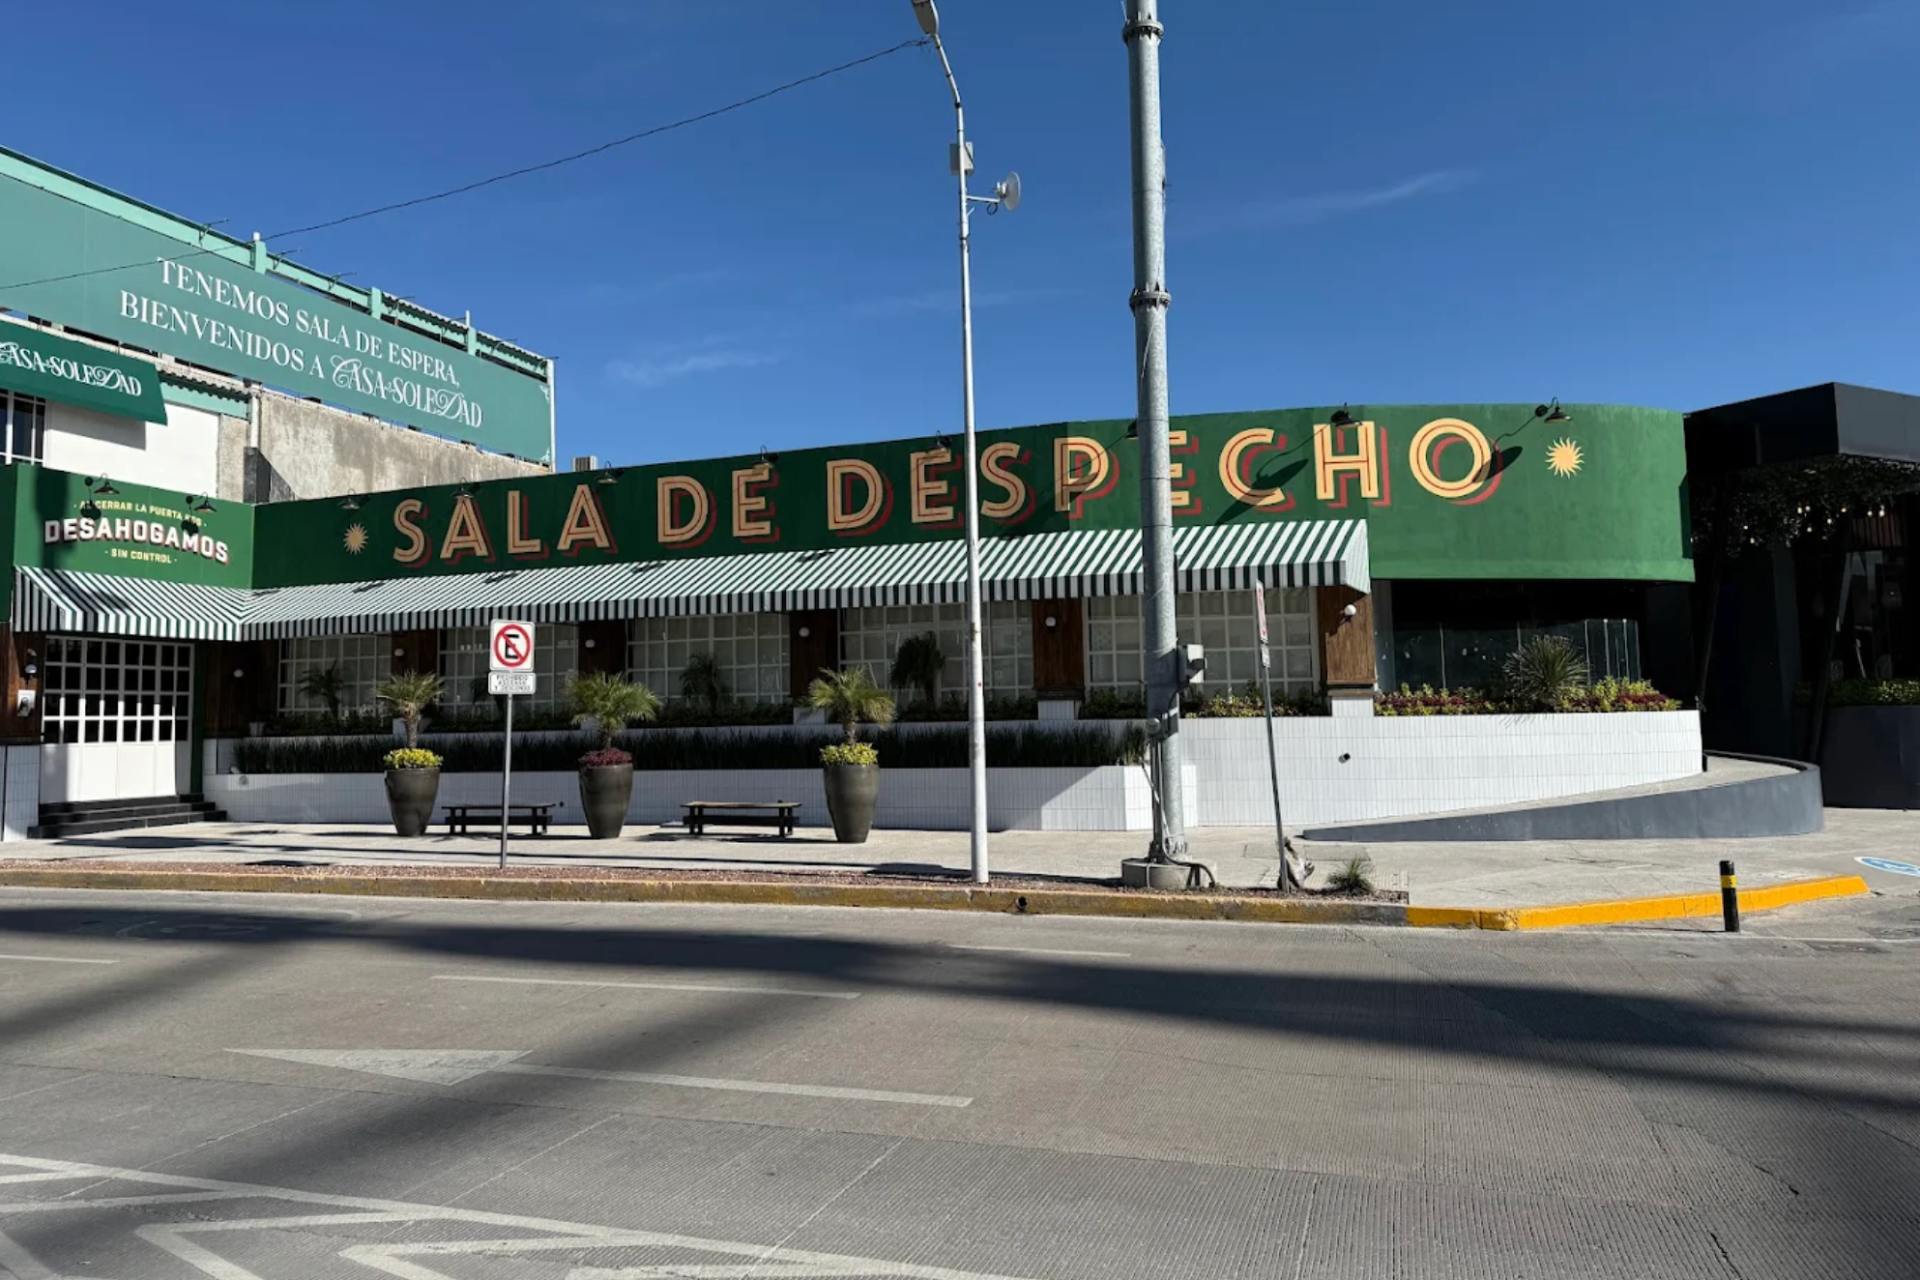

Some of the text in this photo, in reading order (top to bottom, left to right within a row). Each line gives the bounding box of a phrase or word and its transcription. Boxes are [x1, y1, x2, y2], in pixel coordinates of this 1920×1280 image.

[120, 290, 304, 371] BIENVENIDOS
[309, 354, 324, 379] A
[157, 256, 460, 387] TENEMOS SALA DE ESPERA,
[44, 517, 229, 565] DESAHOGAMOS
[94, 500, 133, 511] CERRAR
[135, 503, 147, 514] LA
[149, 506, 183, 521] PUERTA
[393, 483, 613, 565] SALA
[656, 468, 777, 547] DE
[111, 548, 172, 564] SIN CONTROL
